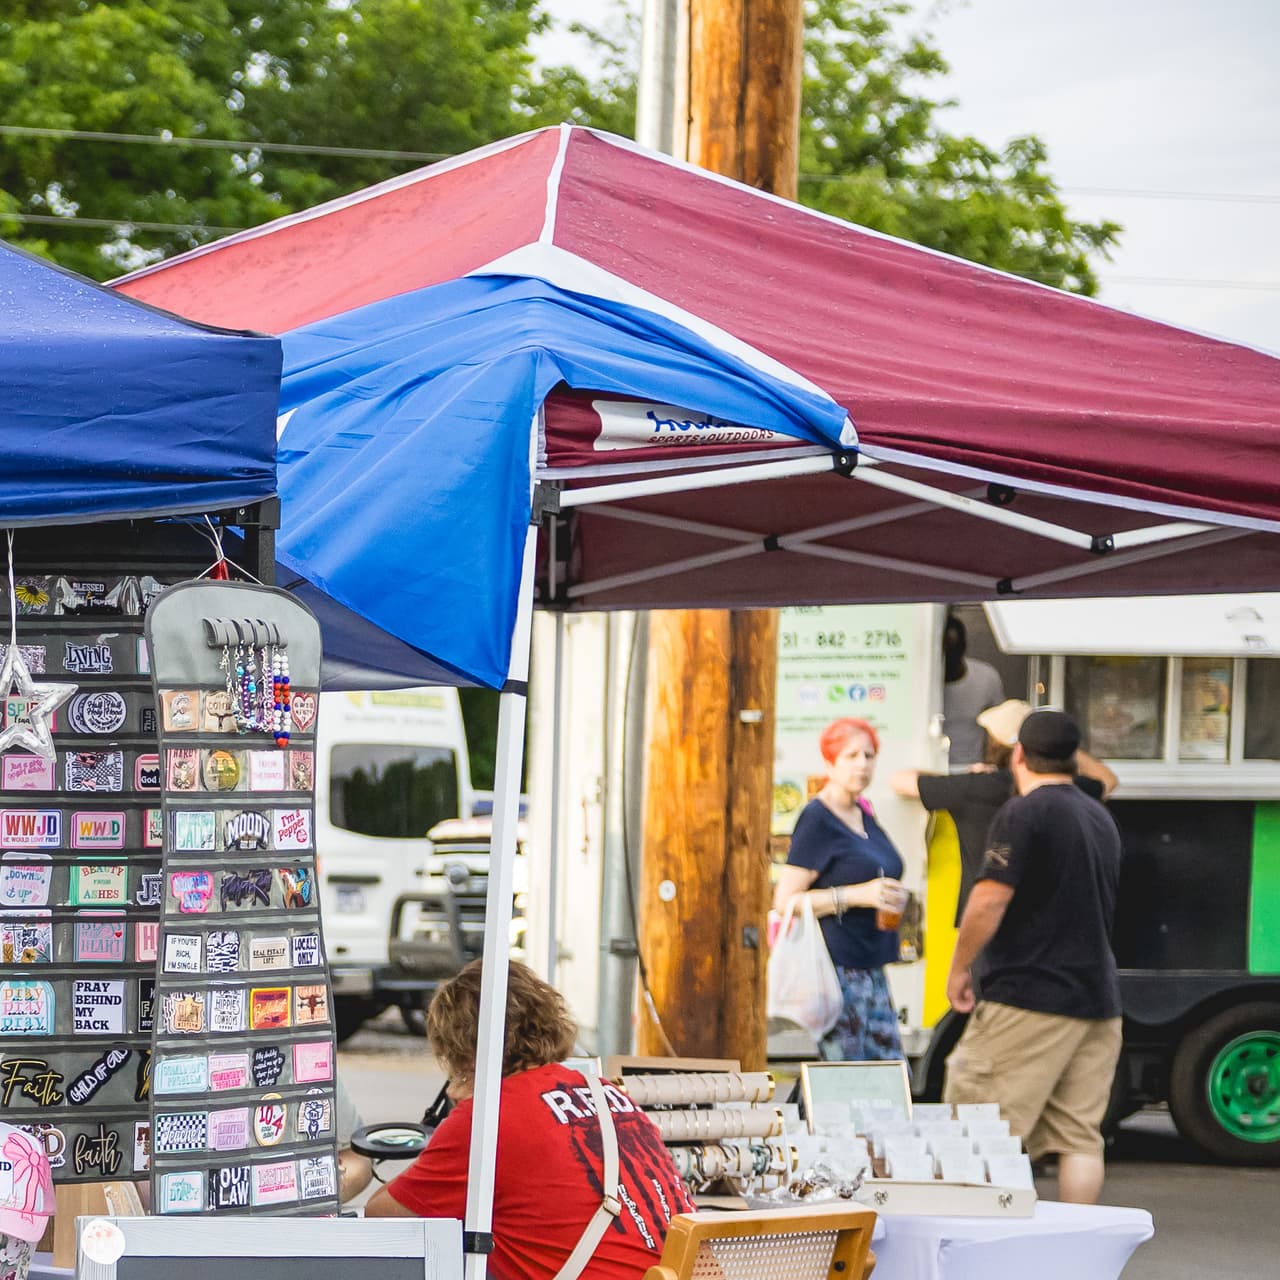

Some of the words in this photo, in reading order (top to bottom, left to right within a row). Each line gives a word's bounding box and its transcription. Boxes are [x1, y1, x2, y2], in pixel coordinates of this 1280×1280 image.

[72, 583, 105, 593] BLESSED
[783, 631, 799, 647] 31
[66, 643, 111, 668] LIVING
[141, 775, 157, 785] God
[5, 815, 57, 836] WWJD
[79, 820, 120, 836] WWJD
[228, 813, 271, 844] MOODY
[278, 820, 305, 842] Pepper
[81, 865, 124, 877] BEAUTY
[83, 889, 120, 900] ASHES
[171, 937, 176, 945] IF
[177, 938, 197, 946] YOU'RE
[294, 938, 317, 951] LOCALS
[177, 961, 198, 970] SINGLE
[297, 952, 314, 965] ONLY
[74, 981, 111, 993] PRAY
[3, 987, 42, 1003] pray
[74, 995, 122, 1006] BEHIND
[74, 1007, 95, 1018] MY
[1, 1016, 45, 1030] pray
[74, 1019, 110, 1031] BACK
[95, 1064, 108, 1081] OF
[0, 1059, 62, 1105] Faith
[161, 1119, 202, 1145] Teacher
[75, 1123, 123, 1174] faith
[219, 1168, 250, 1187] OUT
[219, 1183, 250, 1205] LAW
